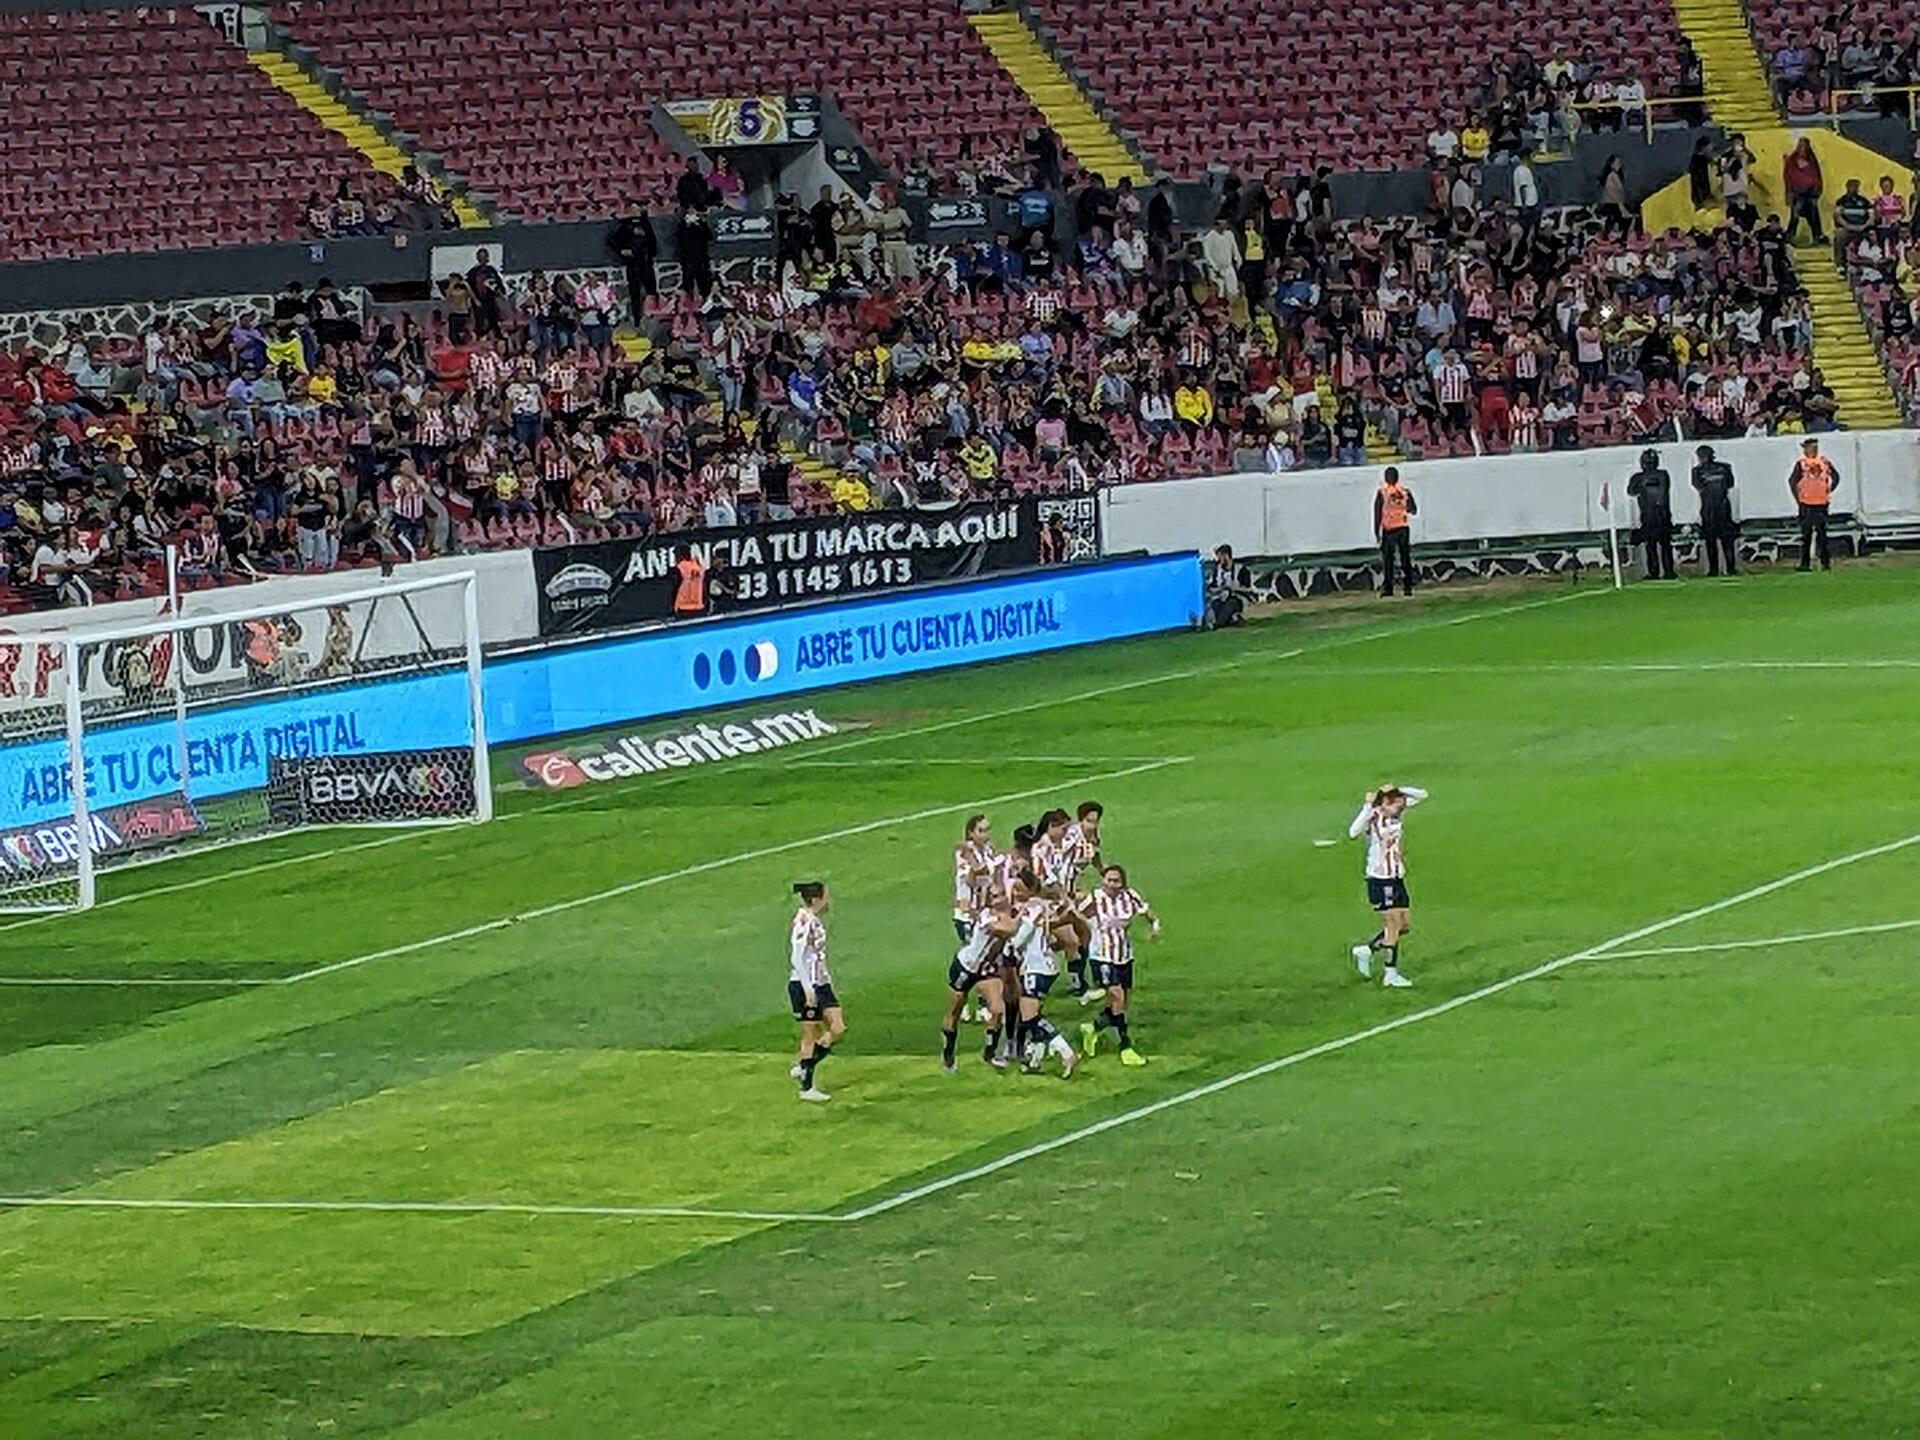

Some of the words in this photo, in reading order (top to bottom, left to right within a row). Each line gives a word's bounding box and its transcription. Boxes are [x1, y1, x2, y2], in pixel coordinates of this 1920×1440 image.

[766, 531, 809, 561] TU
[815, 520, 931, 557] MARCA
[936, 503, 1019, 547] AQUÍ
[736, 572, 769, 600] 33
[777, 564, 842, 596] 1145
[850, 557, 912, 587] 1613
[795, 627, 853, 672] ABRE
[856, 622, 886, 661] TU
[891, 610, 978, 656] CUENTA
[982, 597, 1061, 642] DIGITAL
[101, 750, 140, 793] TU
[147, 730, 260, 785] CUENTA
[263, 712, 366, 758] DIGITAL
[577, 708, 838, 781] caliente.mx
[311, 766, 407, 804] BBVA
